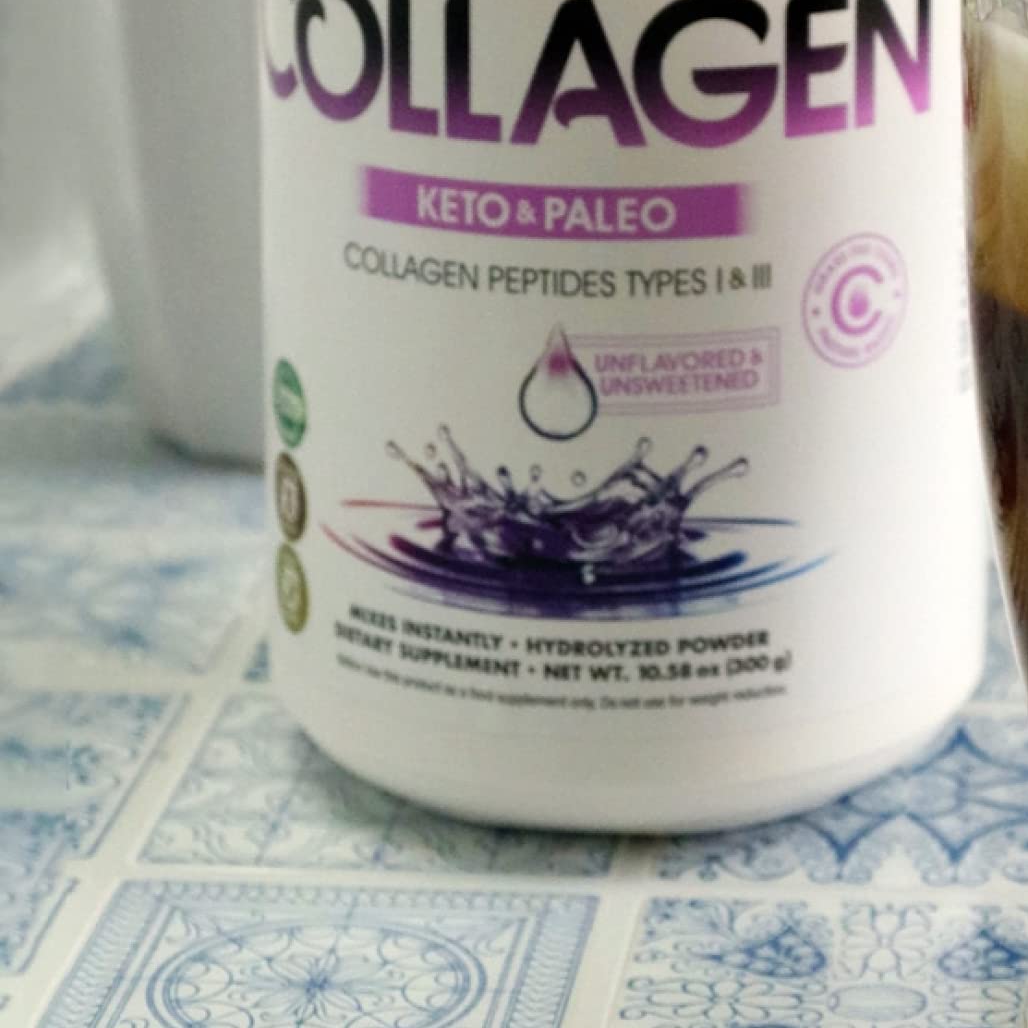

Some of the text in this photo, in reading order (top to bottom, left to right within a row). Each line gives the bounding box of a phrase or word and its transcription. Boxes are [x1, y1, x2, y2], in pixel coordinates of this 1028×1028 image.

[415, 183, 677, 233] KETO & PALEO
[343, 241, 480, 291] COLLAGEN
[488, 263, 616, 298] PEPTIDES
[624, 267, 708, 297] TYPES
[728, 266, 746, 290] &
[594, 348, 746, 372] UNFLAVORED
[601, 369, 759, 396] UNSWEETENED
[401, 619, 504, 651] INSTANTLY
[525, 636, 670, 657] HYDROLYZED
[677, 629, 769, 655] POWDER
[399, 643, 521, 678] SUPPLEMENT
[543, 663, 581, 681] NET
